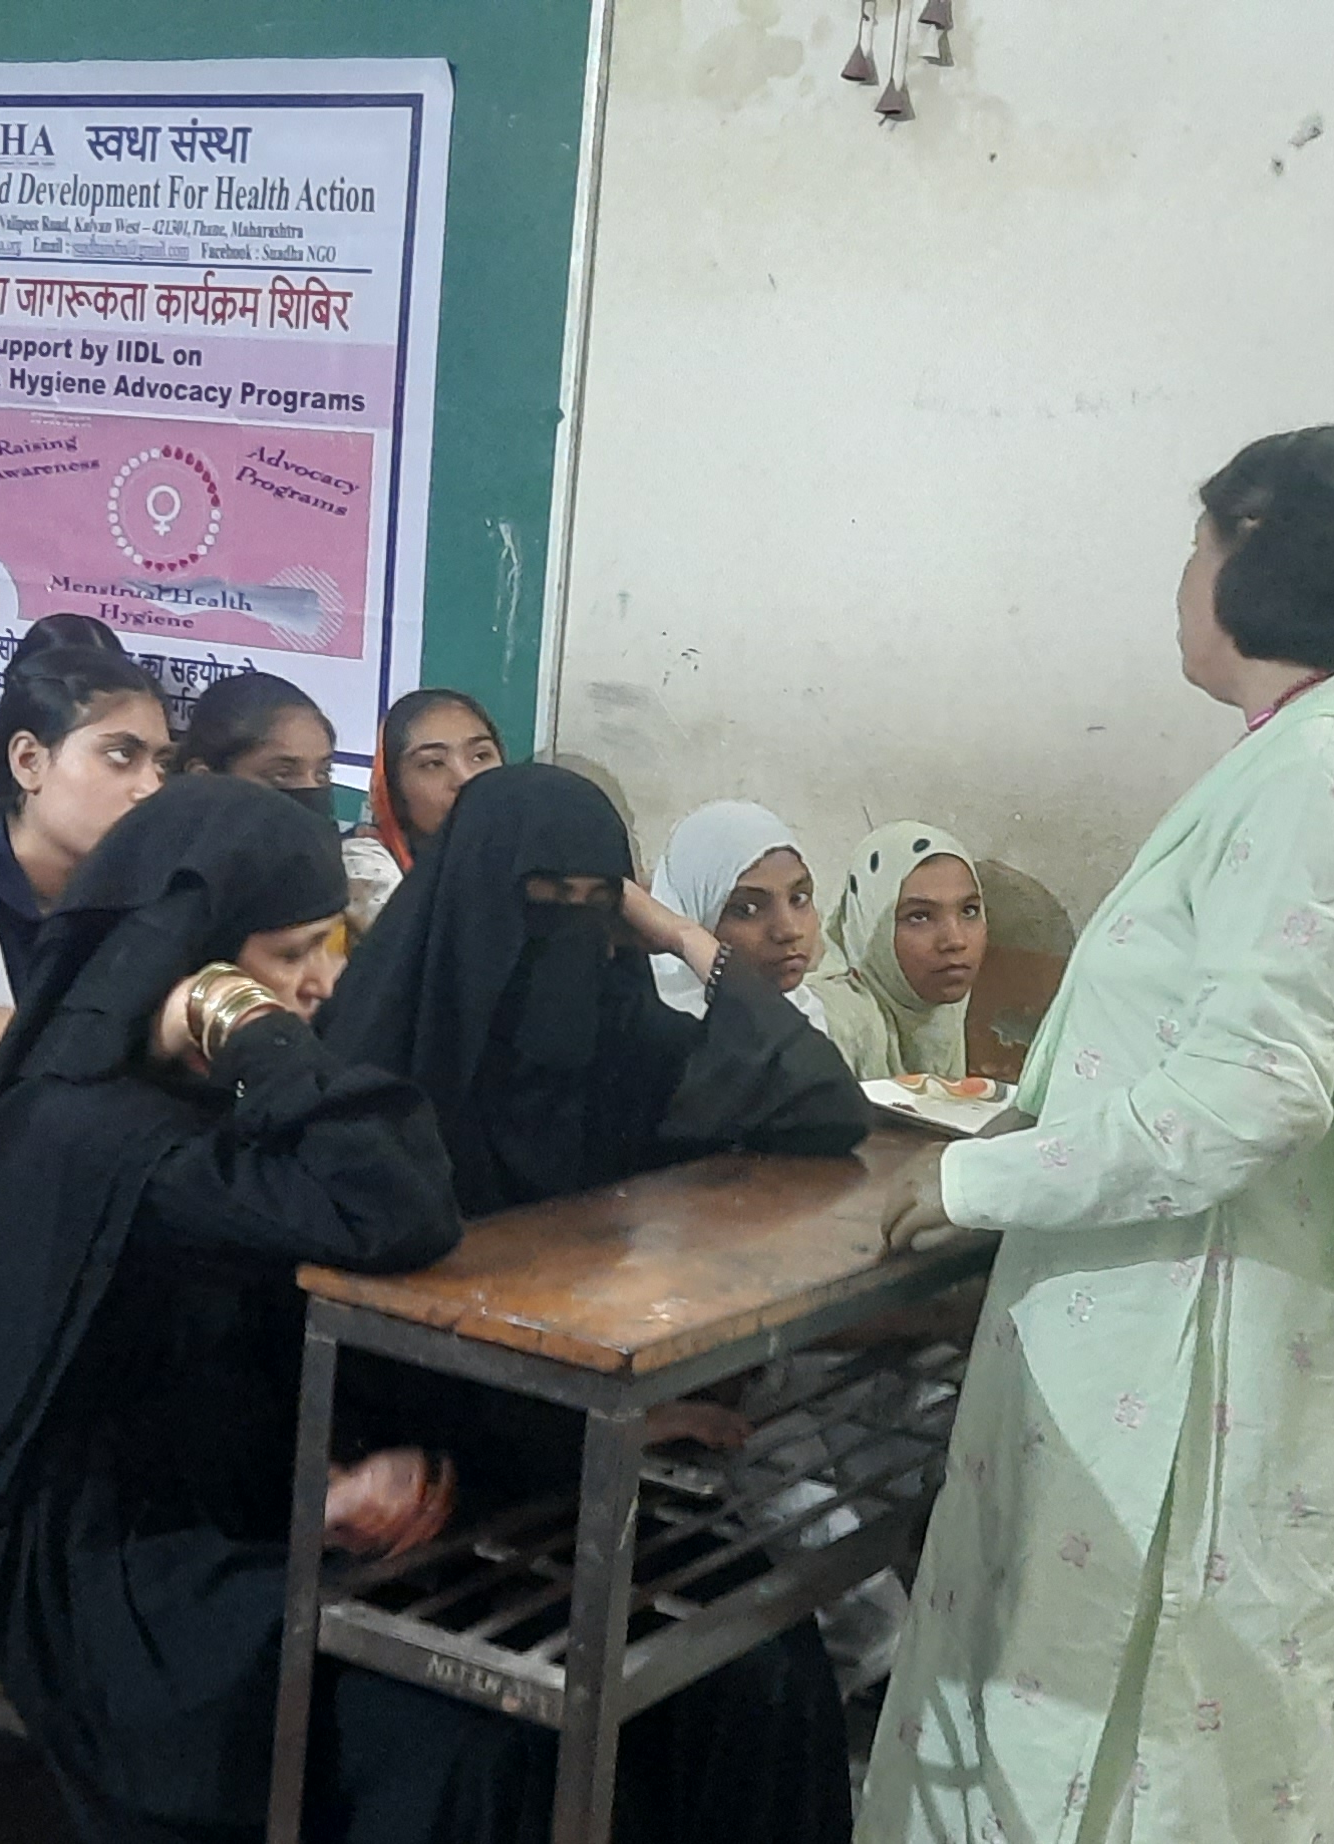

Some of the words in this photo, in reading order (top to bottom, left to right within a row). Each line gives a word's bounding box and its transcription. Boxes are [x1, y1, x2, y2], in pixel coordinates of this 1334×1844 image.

[86, 125, 161, 163] स्वधा
[168, 118, 252, 164] संस्था
[17, 173, 160, 216] Development
[167, 175, 209, 209] For
[215, 176, 289, 211] Health
[295, 176, 375, 213] Action
[231, 221, 304, 239] Maharashtra
[307, 246, 337, 262] NGO
[15, 279, 148, 322] जागरूकता
[154, 270, 262, 328] कार्यक्रम
[268, 274, 353, 331] शिबिर
[80, 338, 108, 366] by
[116, 340, 165, 364] IIDL
[173, 349, 202, 366] on
[9, 367, 106, 396] Hygiene
[113, 375, 232, 409] Advocacy
[240, 382, 365, 414] Programs
[235, 466, 348, 516] Programs
[245, 446, 360, 495] Advocacy
[51, 574, 168, 601] Menstrual
[172, 588, 253, 612] Health
[99, 602, 195, 629] Hygiene
